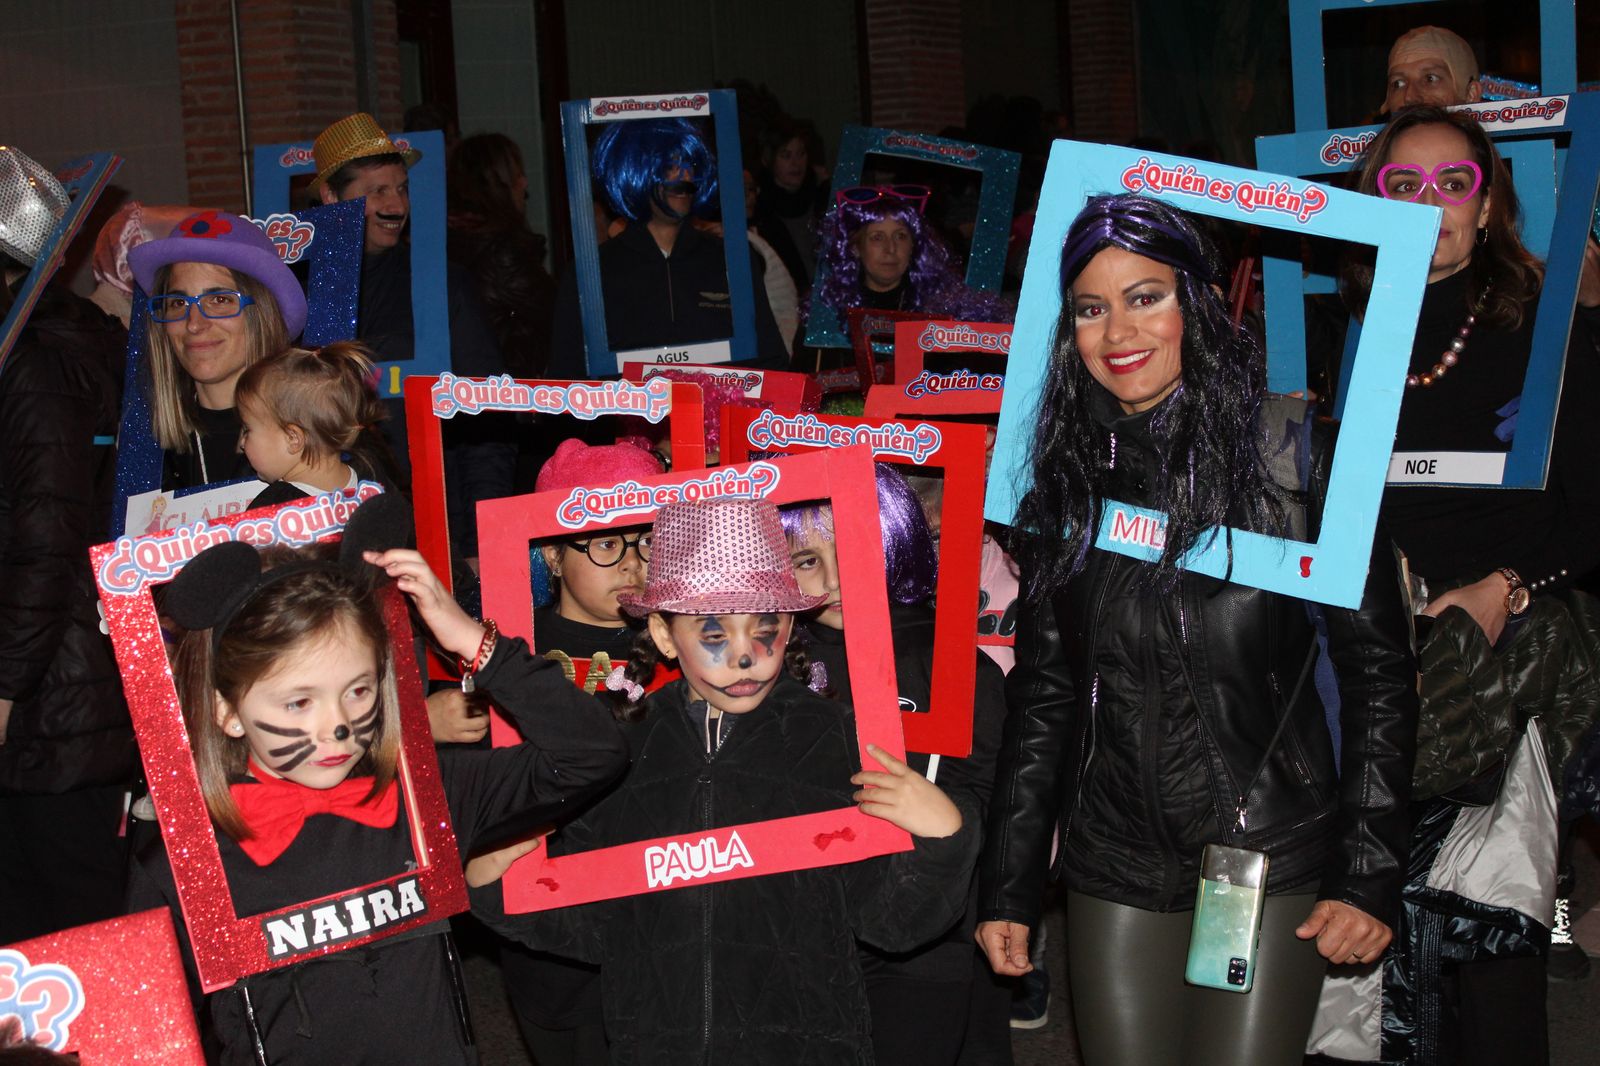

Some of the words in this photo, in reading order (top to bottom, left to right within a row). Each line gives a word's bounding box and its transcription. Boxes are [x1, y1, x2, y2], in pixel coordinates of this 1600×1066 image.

[1482, 110, 1498, 120] es
[1501, 98, 1566, 120] Quién?
[1322, 136, 1375, 163] ¿Qui
[1123, 159, 1206, 191] ¿Quién
[1208, 181, 1235, 200] es
[1236, 184, 1326, 220] Quién?
[266, 220, 293, 238] es
[919, 325, 978, 349] ¿Quién
[980, 333, 997, 346] es
[656, 351, 689, 363] AGUS
[432, 375, 530, 413] ¿Quién
[533, 388, 563, 408] es
[568, 380, 670, 418] Quién?
[906, 371, 978, 397] ¿Quién
[980, 376, 1001, 389] es
[751, 414, 826, 443] ¿Quién
[829, 429, 851, 444] es
[1404, 459, 1438, 475] NOE
[563, 484, 650, 521] ¿Quién
[654, 488, 680, 504] es
[684, 468, 775, 500] Quién?
[105, 522, 231, 588] ¿Quién
[241, 522, 275, 546] es
[647, 834, 751, 884] PAULA
[266, 879, 425, 956] NAIRA
